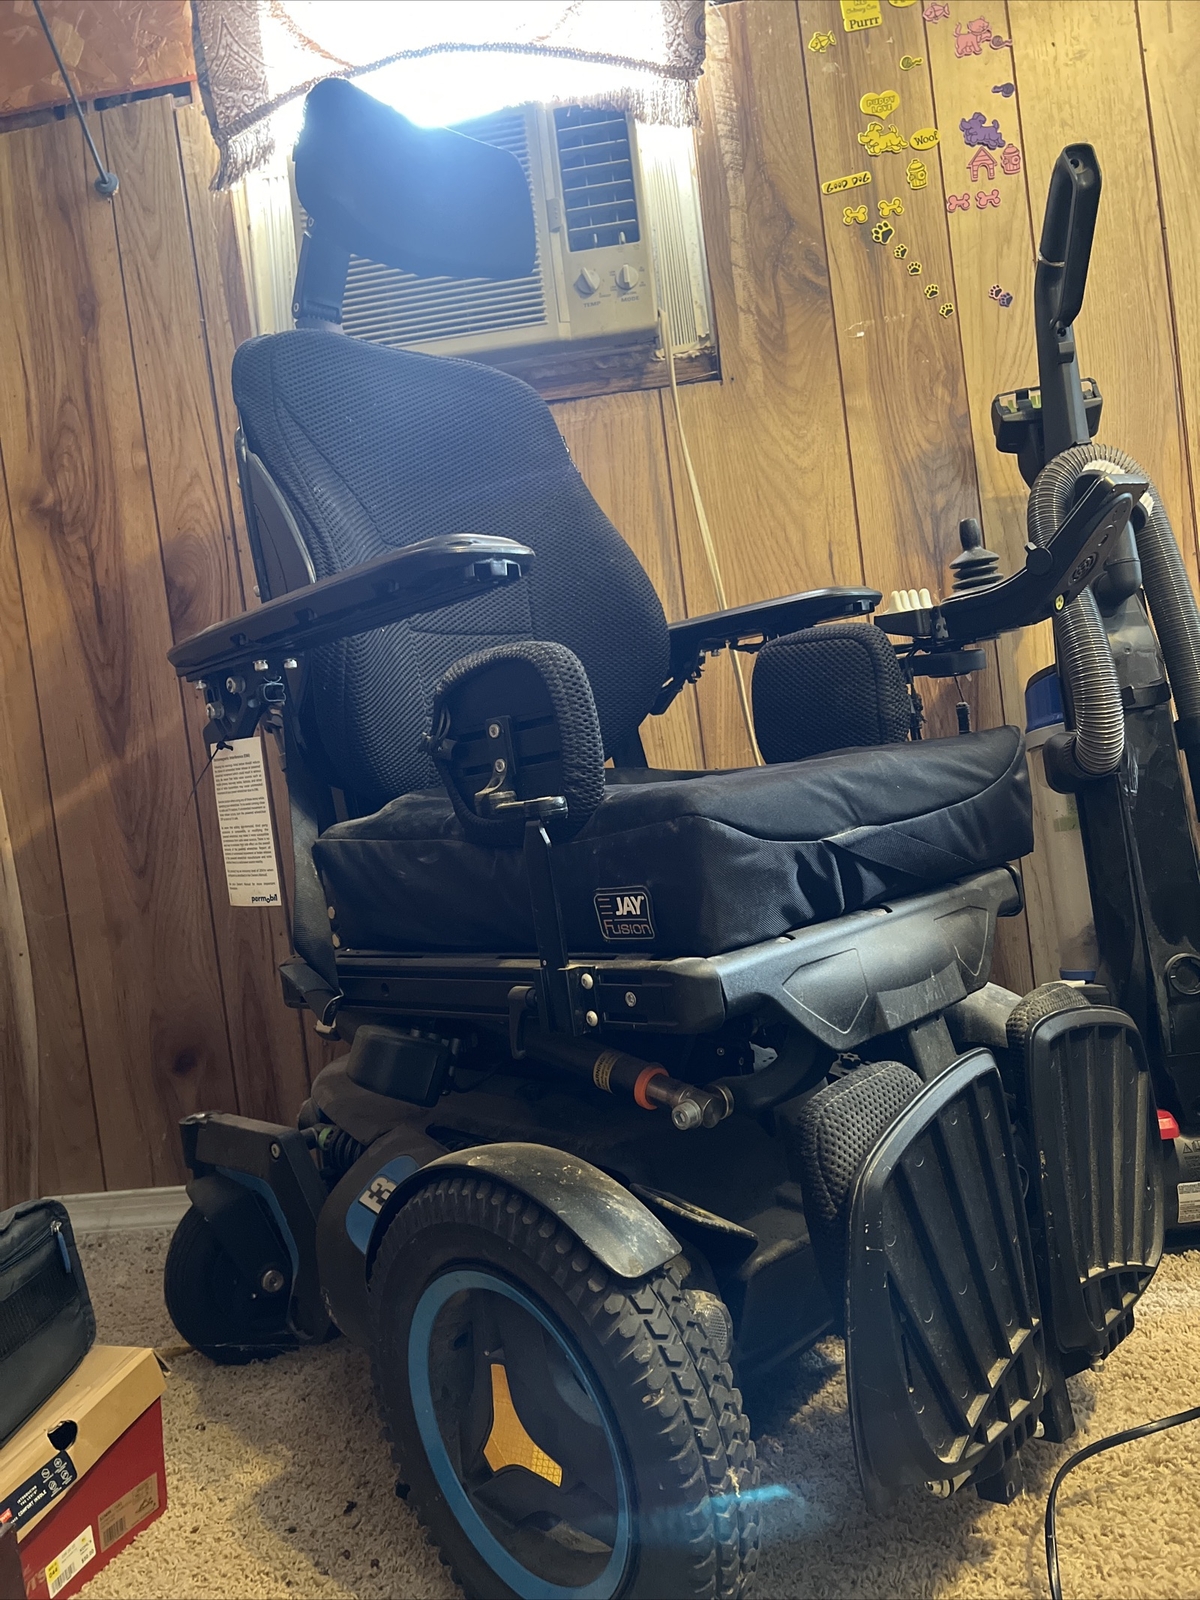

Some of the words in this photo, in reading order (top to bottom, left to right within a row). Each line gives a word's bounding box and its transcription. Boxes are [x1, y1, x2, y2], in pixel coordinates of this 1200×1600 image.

[849, 16, 880, 29] Purrr
[866, 95, 896, 107] PUPPY
[871, 104, 893, 113] LOVE
[914, 131, 938, 146] Woof
[826, 180, 848, 193] GOOD
[851, 173, 870, 185] DOG
[251, 893, 278, 904] permobil
[615, 895, 643, 916] JAY
[603, 919, 652, 935] Fusion
[359, 1177, 397, 1214] F3
[18, 1500, 34, 1516] COMFORT
[34, 1489, 47, 1502] INSOLE
